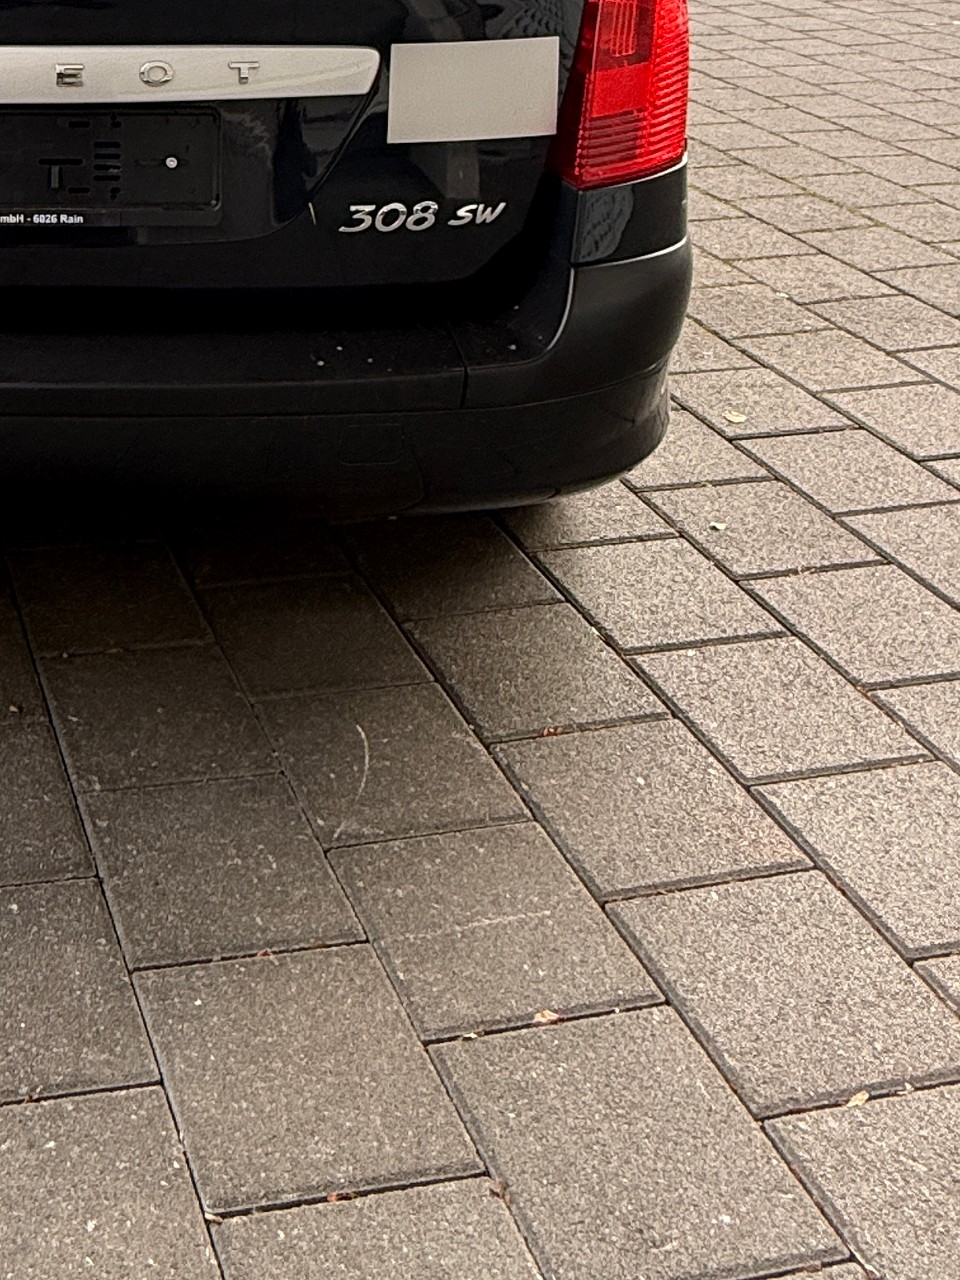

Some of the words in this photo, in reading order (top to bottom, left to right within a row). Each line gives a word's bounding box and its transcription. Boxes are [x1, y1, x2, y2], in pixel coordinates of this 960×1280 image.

[33, 214, 58, 224] 6026
[60, 214, 84, 224] Rain
[338, 200, 439, 233] 308
[447, 202, 507, 226] SW
